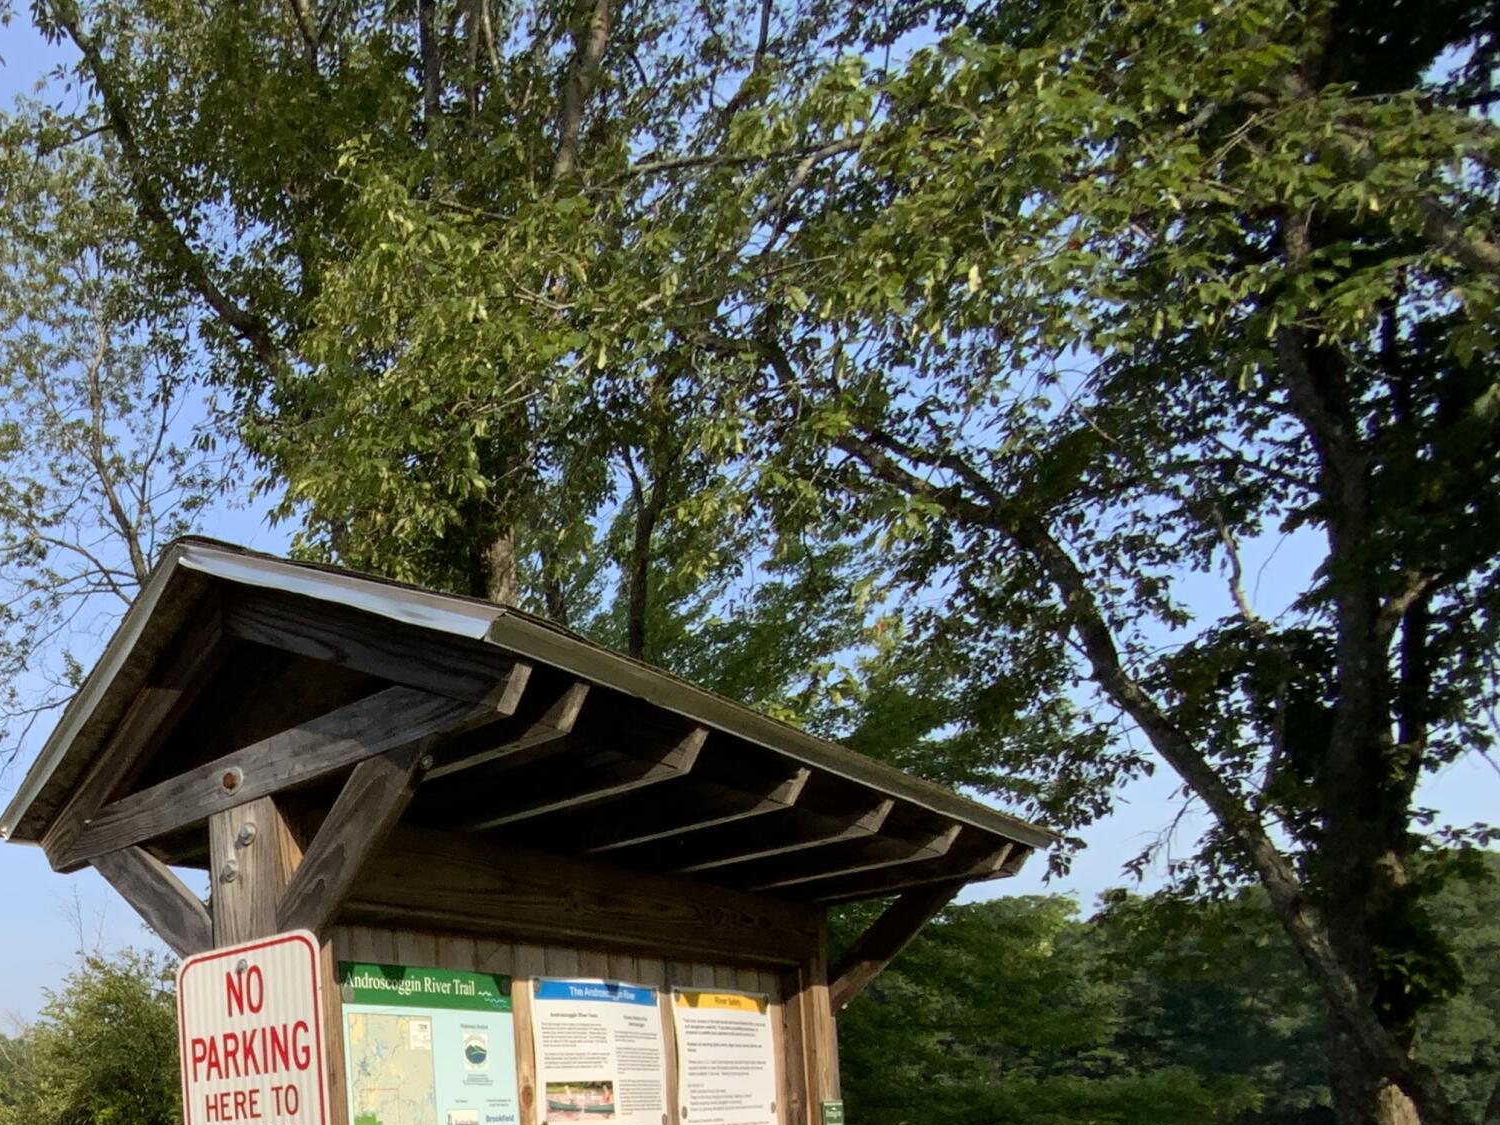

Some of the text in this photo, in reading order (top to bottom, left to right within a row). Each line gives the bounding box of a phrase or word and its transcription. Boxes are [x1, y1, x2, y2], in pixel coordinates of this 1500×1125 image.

[226, 965, 264, 1017] NO
[344, 972, 475, 996] Androscoggin River Trail
[569, 986, 583, 997] The
[191, 1020, 311, 1083] PARKING
[205, 1084, 299, 1123] HERE TO
